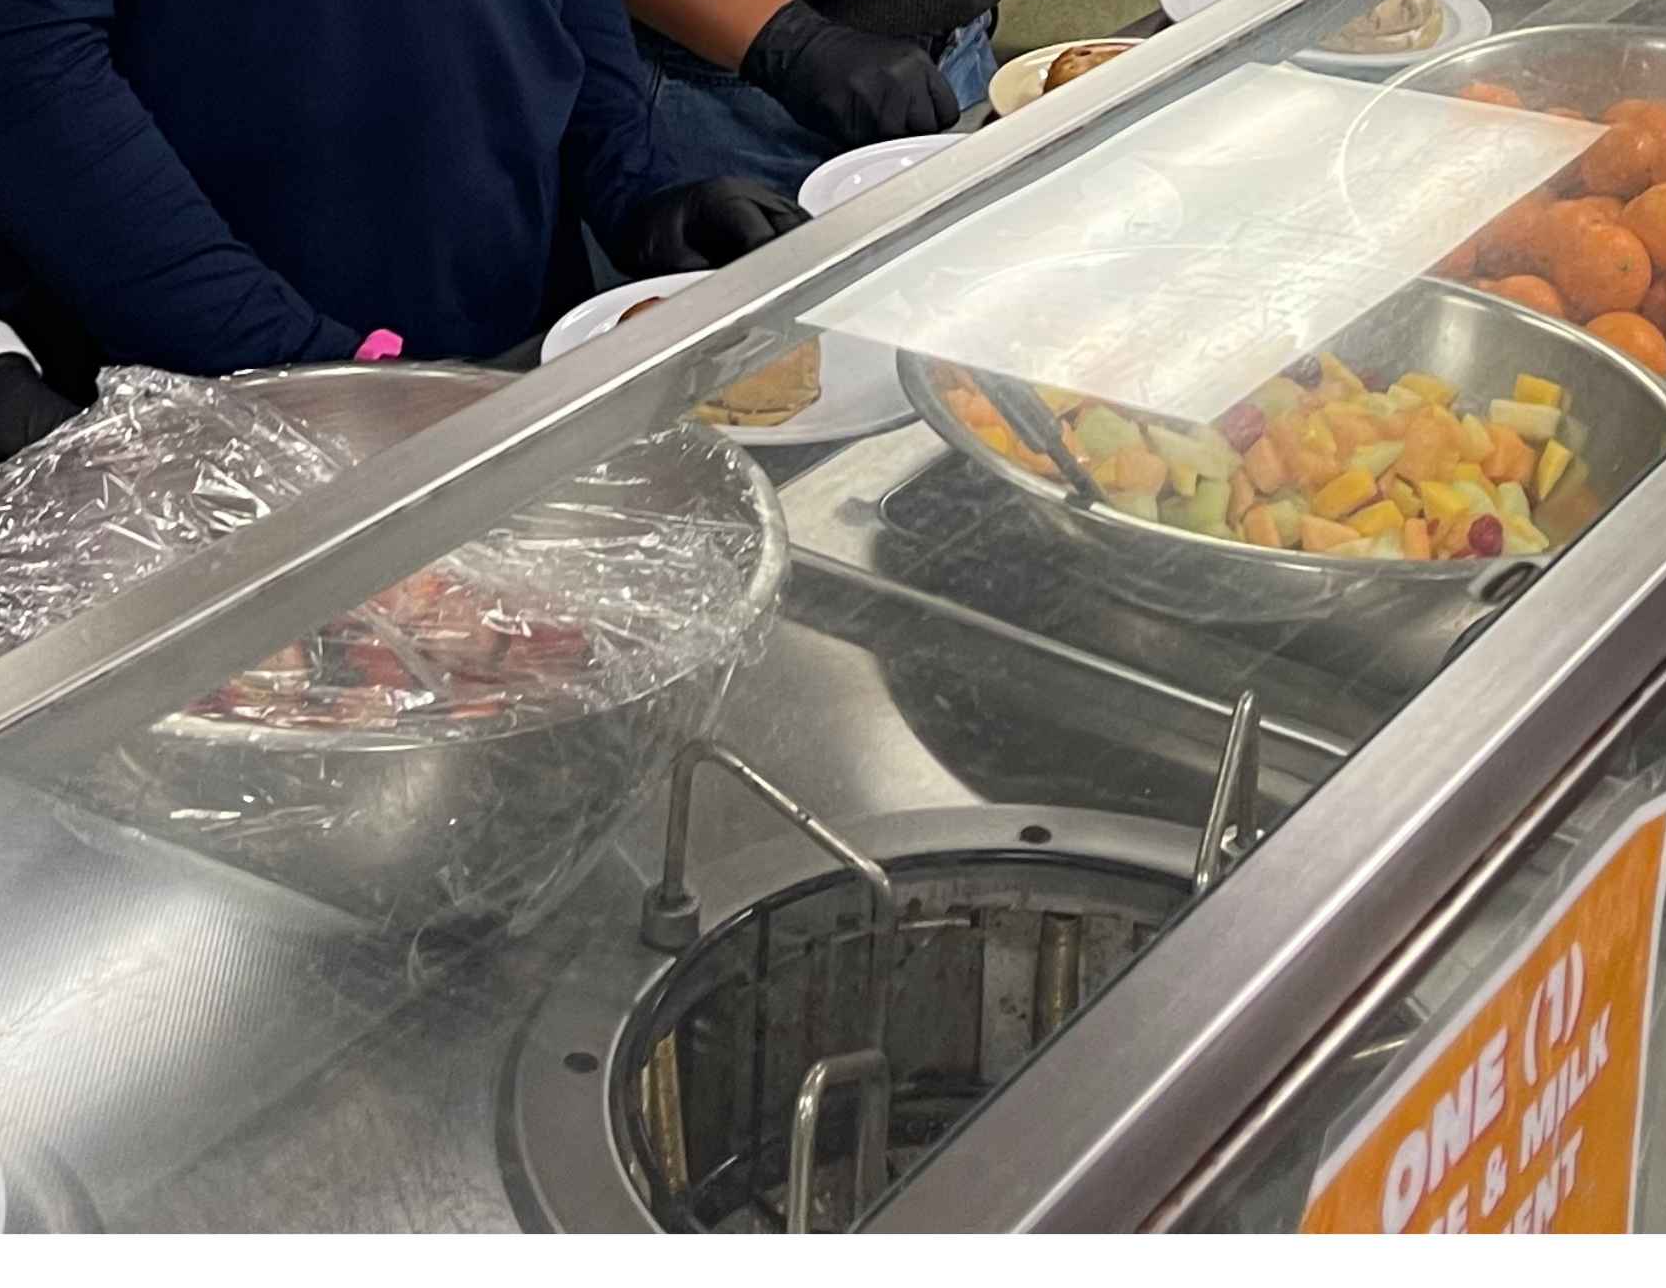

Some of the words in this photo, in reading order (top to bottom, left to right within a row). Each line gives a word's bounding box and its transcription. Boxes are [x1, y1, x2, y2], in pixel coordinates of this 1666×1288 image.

[1381, 1026, 1510, 1234] ONE
[1522, 941, 1585, 1087] (1)
[1480, 1143, 1509, 1217] &
[1518, 1001, 1612, 1174] MILK
[1502, 1127, 1583, 1234] ENT
